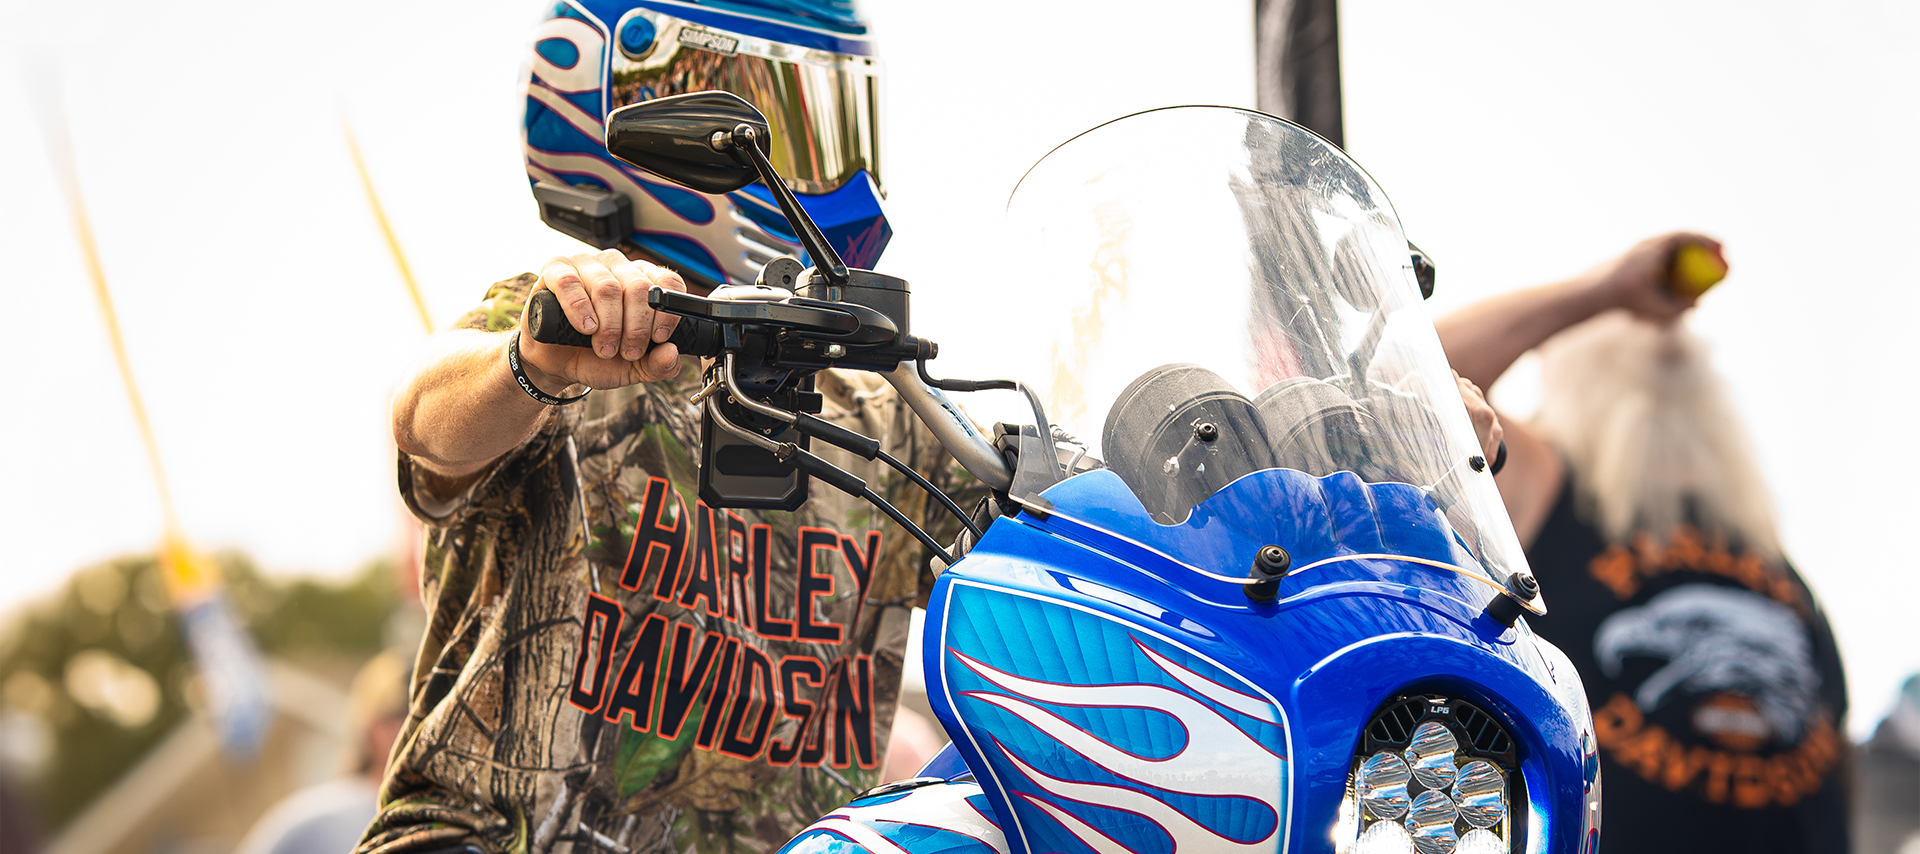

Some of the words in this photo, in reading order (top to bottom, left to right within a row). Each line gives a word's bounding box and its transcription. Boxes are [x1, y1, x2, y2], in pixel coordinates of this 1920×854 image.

[680, 28, 738, 53] SIMPSON
[517, 375, 539, 400] CALL
[619, 476, 882, 645] HARLEY
